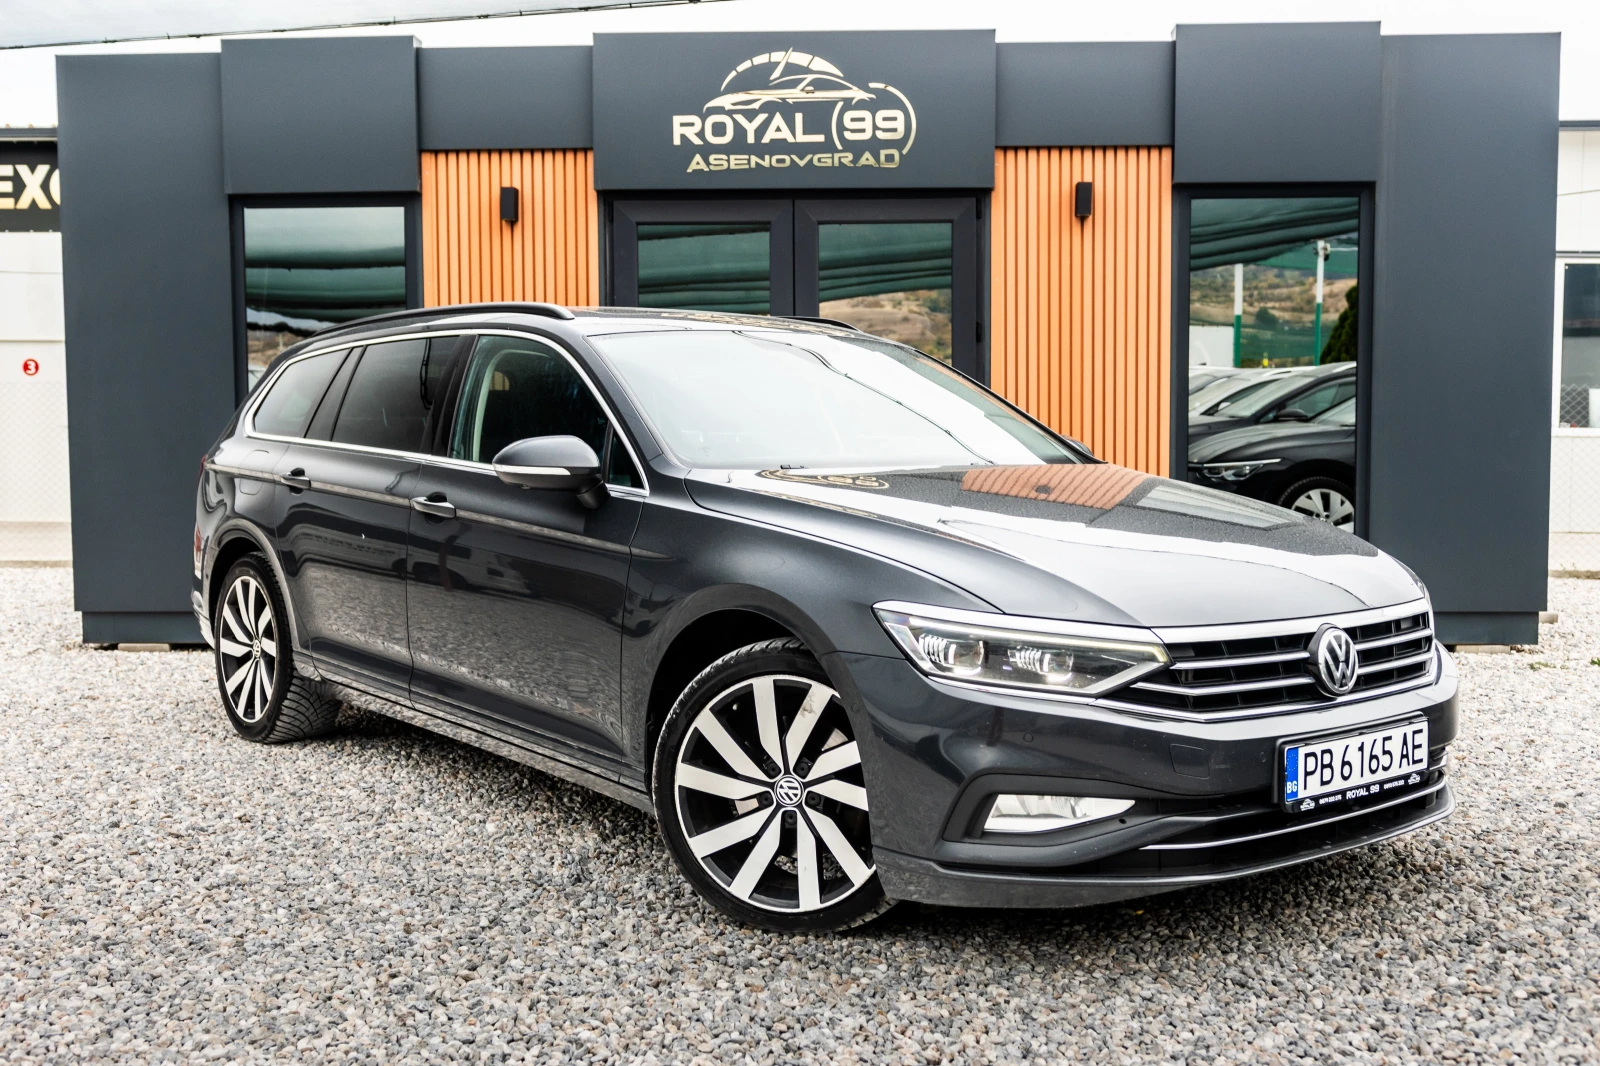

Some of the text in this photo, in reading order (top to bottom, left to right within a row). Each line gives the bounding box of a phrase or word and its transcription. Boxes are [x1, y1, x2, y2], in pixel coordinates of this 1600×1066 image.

[672, 111, 825, 146] ROYAL
[686, 149, 900, 173] ASENOVGRAD
[25, 360, 37, 375] 3
[1286, 780, 1298, 794] BG
[1346, 786, 1369, 800] ROYAL
[1370, 783, 1380, 794] 99
